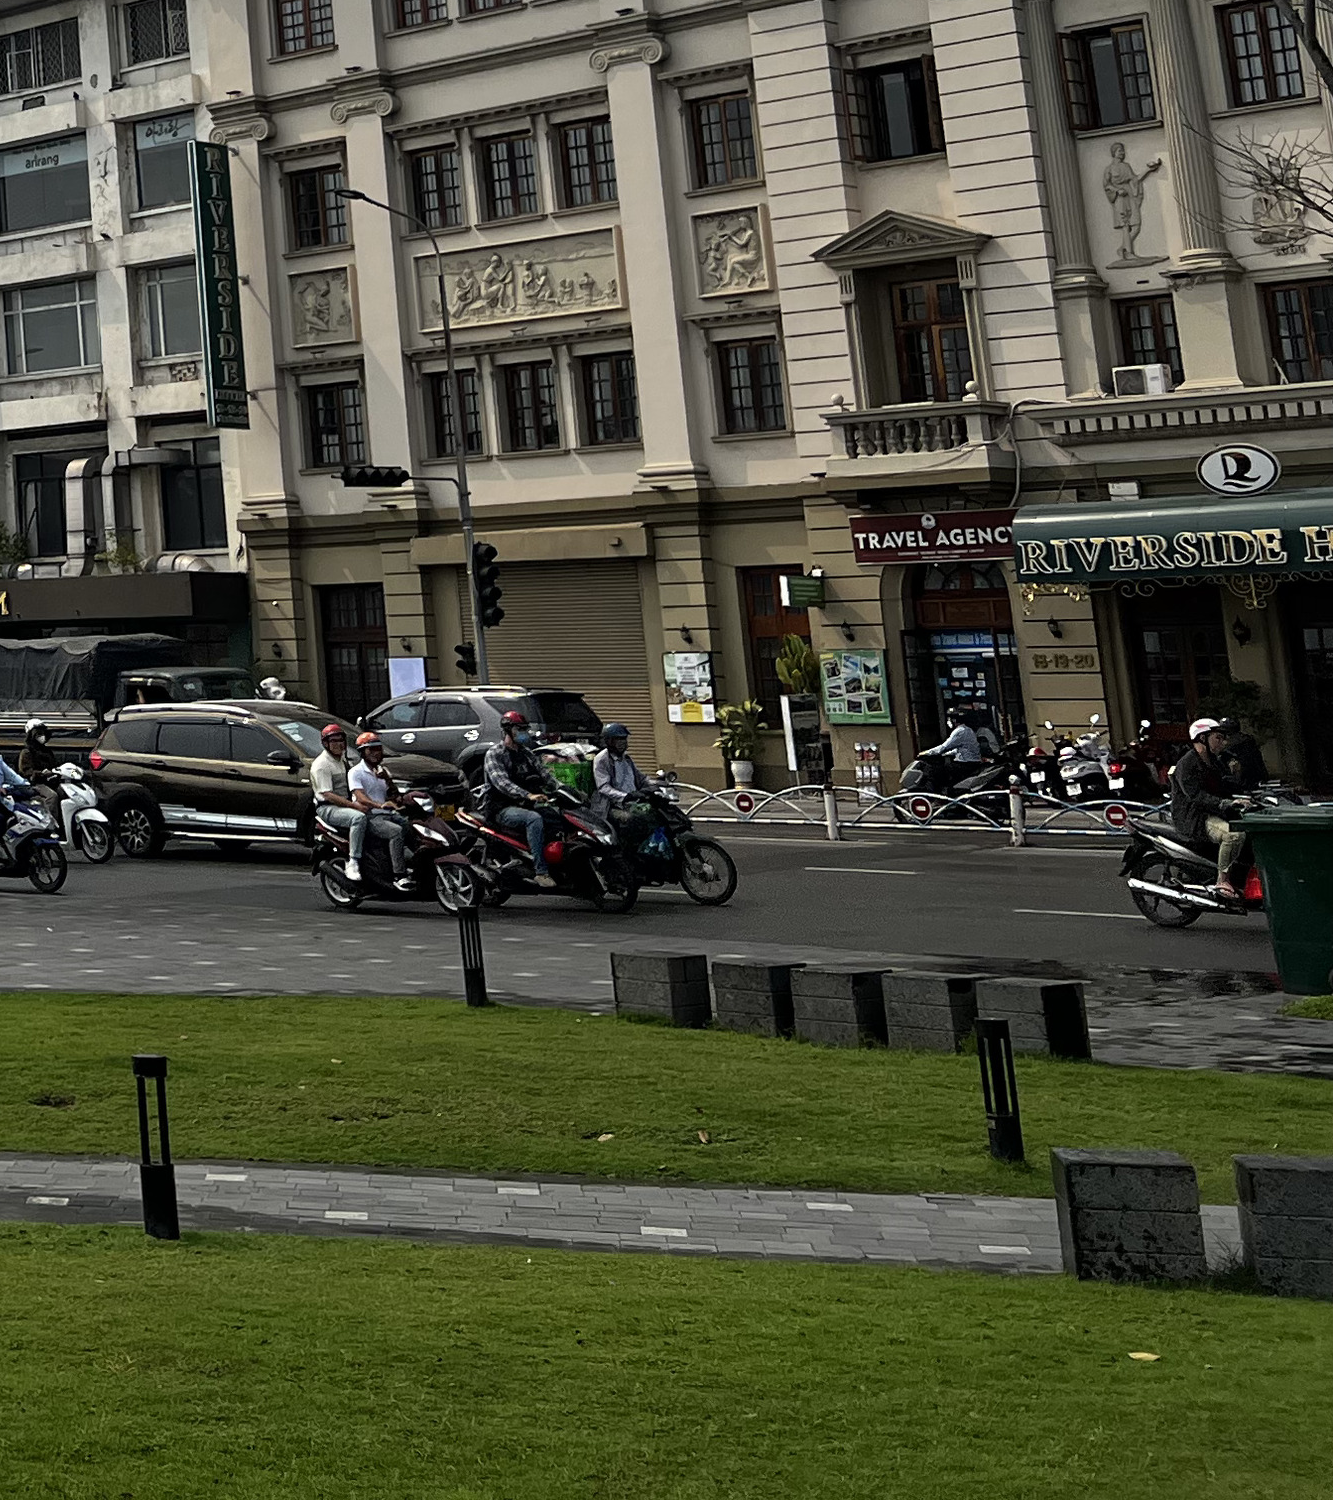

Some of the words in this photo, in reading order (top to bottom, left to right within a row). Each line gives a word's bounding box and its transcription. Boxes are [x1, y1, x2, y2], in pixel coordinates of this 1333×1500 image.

[25, 153, 59, 169] arirang
[204, 146, 240, 388] RIVERSIDE
[854, 531, 929, 550] TRAVEL
[1017, 528, 1288, 575] RIVERSIDE
